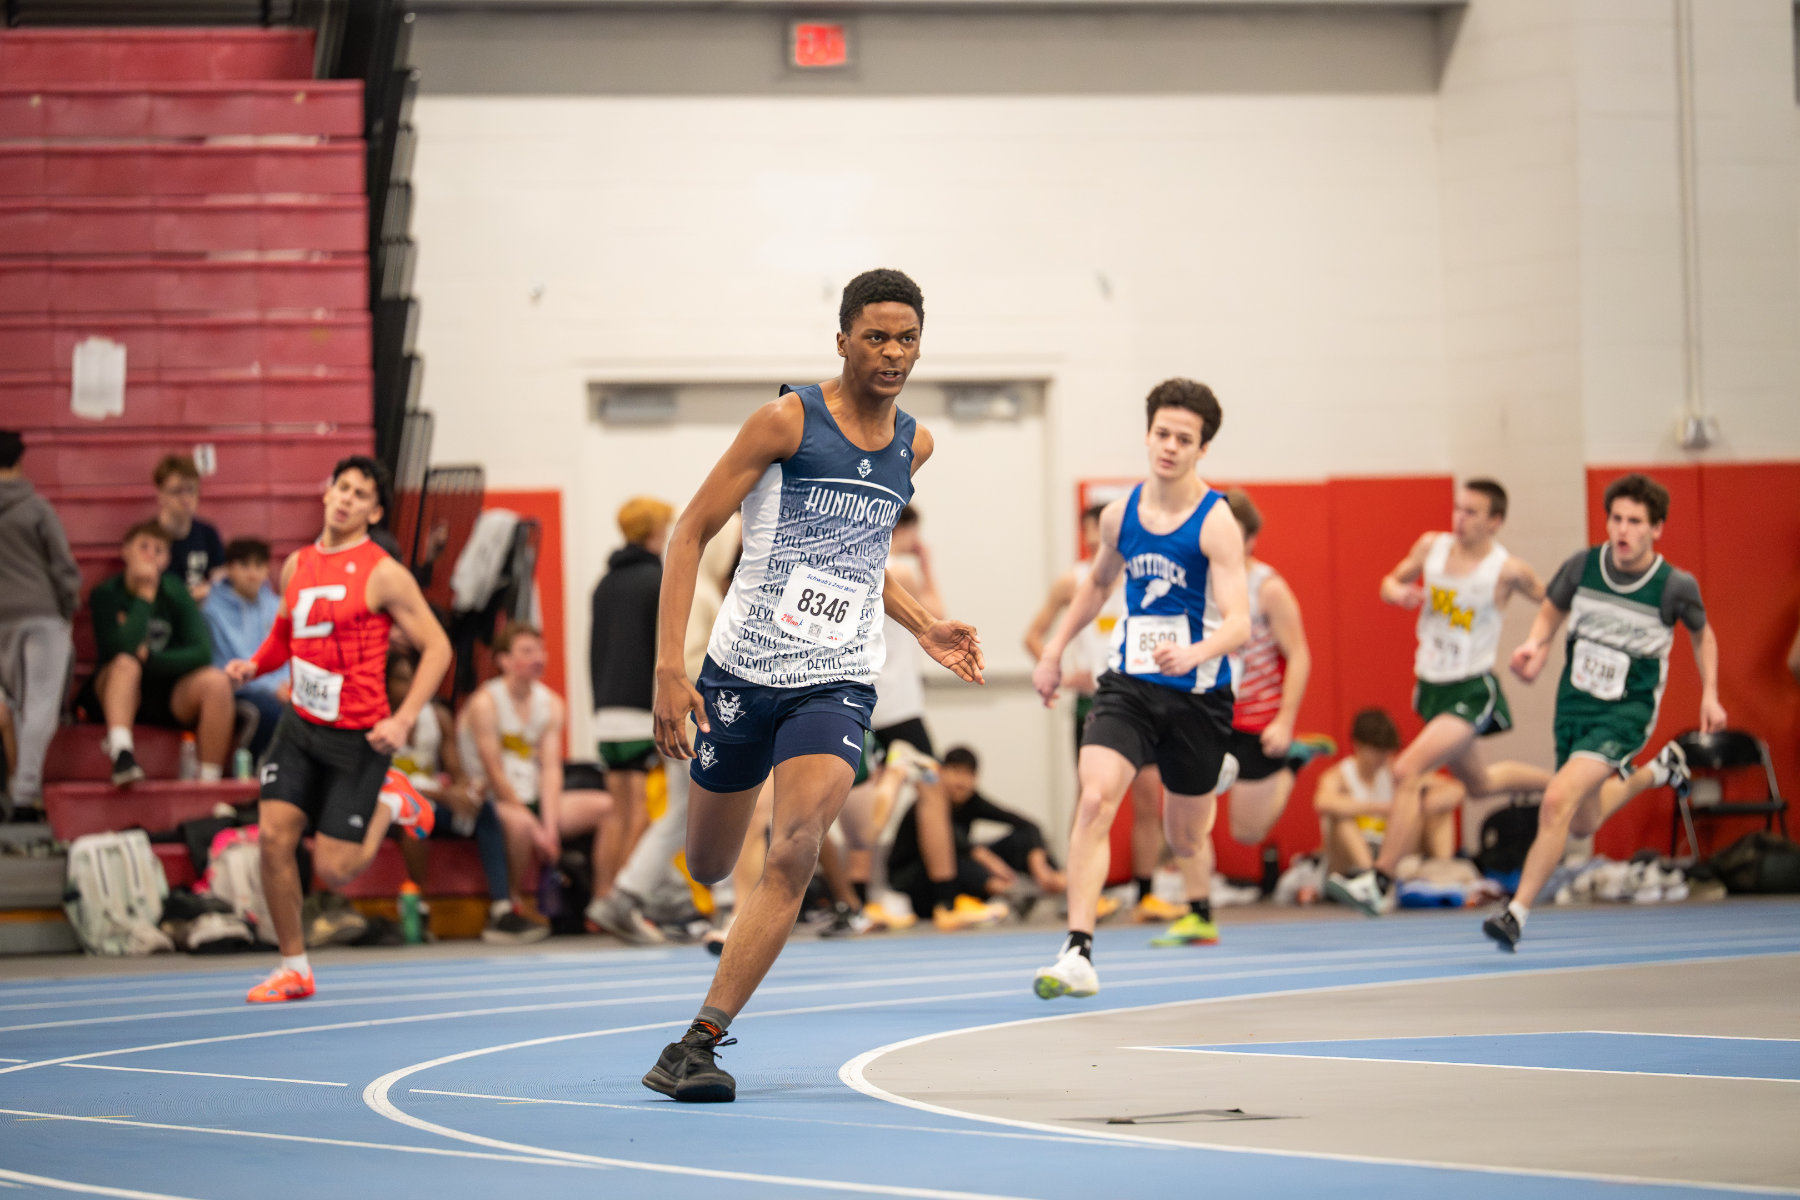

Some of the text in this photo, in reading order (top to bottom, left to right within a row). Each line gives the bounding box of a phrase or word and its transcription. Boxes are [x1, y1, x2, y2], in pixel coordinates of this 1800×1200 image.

[804, 486, 900, 526] HUNTINGTON
[806, 525, 841, 541] DEVILS
[799, 551, 836, 568] DEVILS
[806, 573, 831, 586] Schwab's
[292, 584, 347, 639] C
[797, 588, 850, 624] 8346
[743, 628, 778, 650] DEVILS
[738, 654, 773, 673] DEVILS
[808, 656, 842, 671] DEVILS
[771, 671, 808, 686] DEVILS
